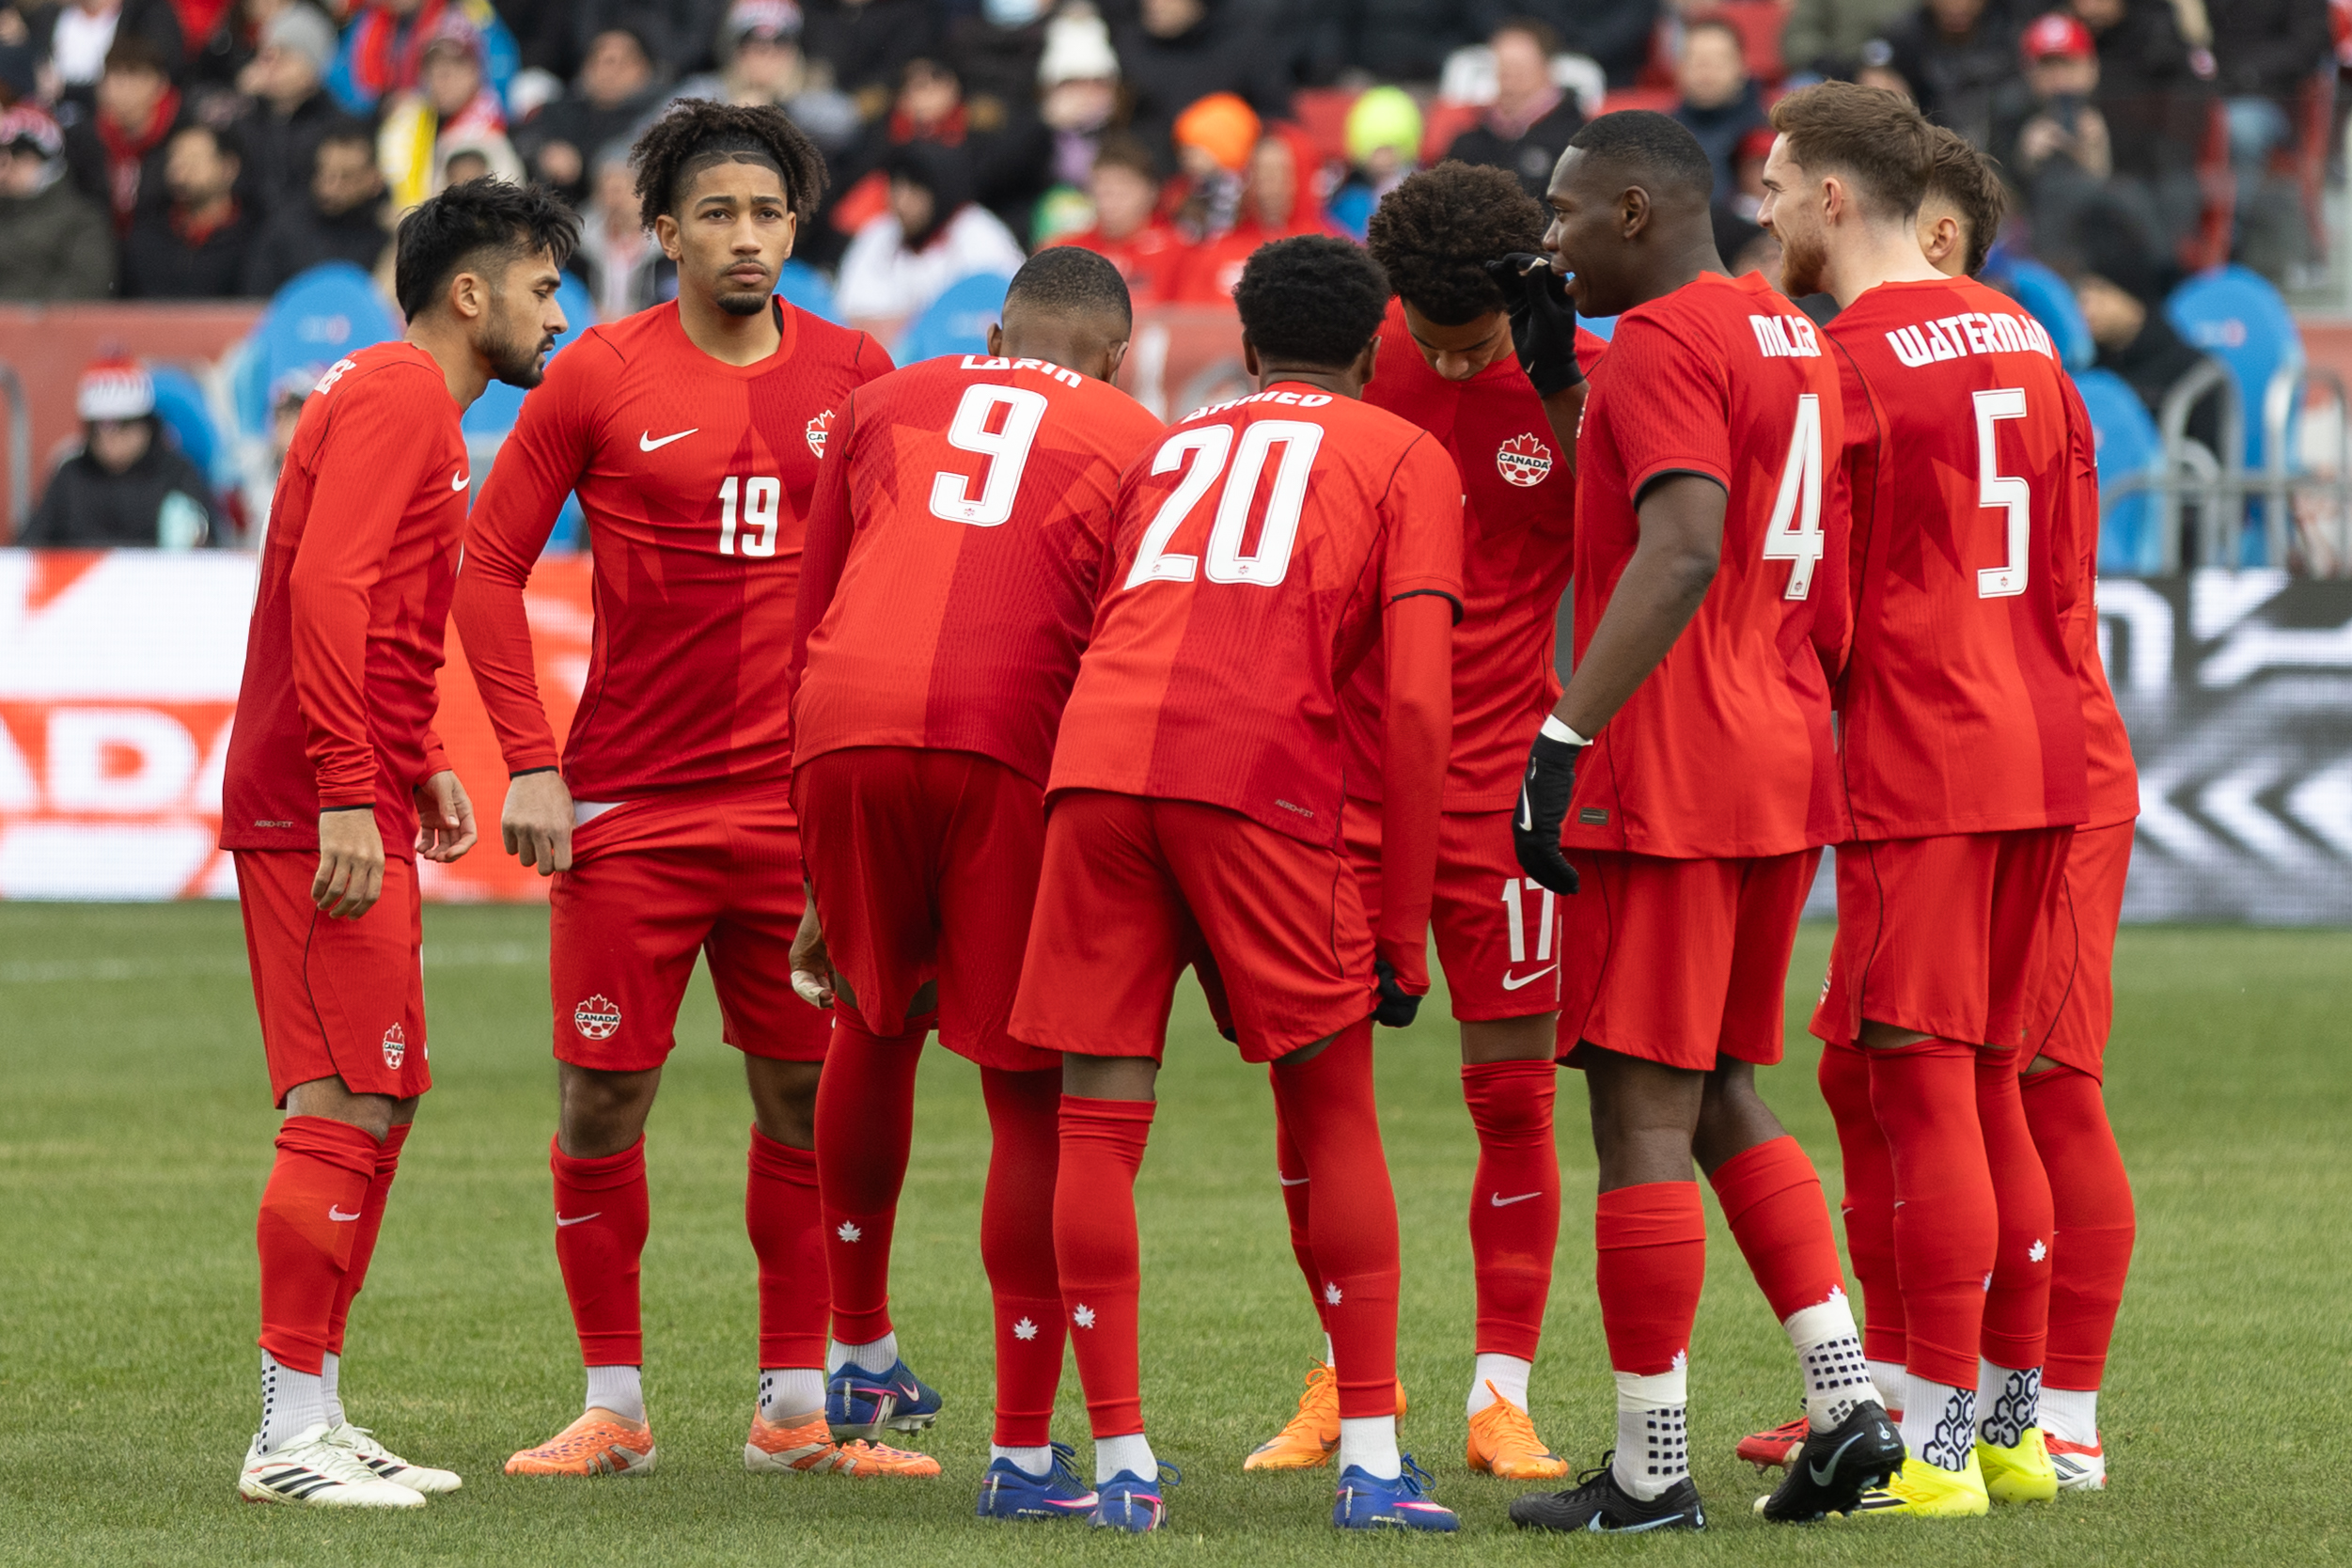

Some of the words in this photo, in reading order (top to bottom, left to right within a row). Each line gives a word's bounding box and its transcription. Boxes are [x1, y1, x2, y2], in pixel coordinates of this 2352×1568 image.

[1885, 312, 2054, 368] WATERMAN
[929, 383, 1048, 527] 9
[1498, 452, 1549, 470] CANADA
[1763, 393, 1825, 601] 4
[1971, 387, 2031, 599] 5
[717, 476, 781, 557] 19
[1122, 419, 1325, 591] 20
[1501, 878, 1555, 963] 17
[575, 1012, 619, 1024] CANADA
